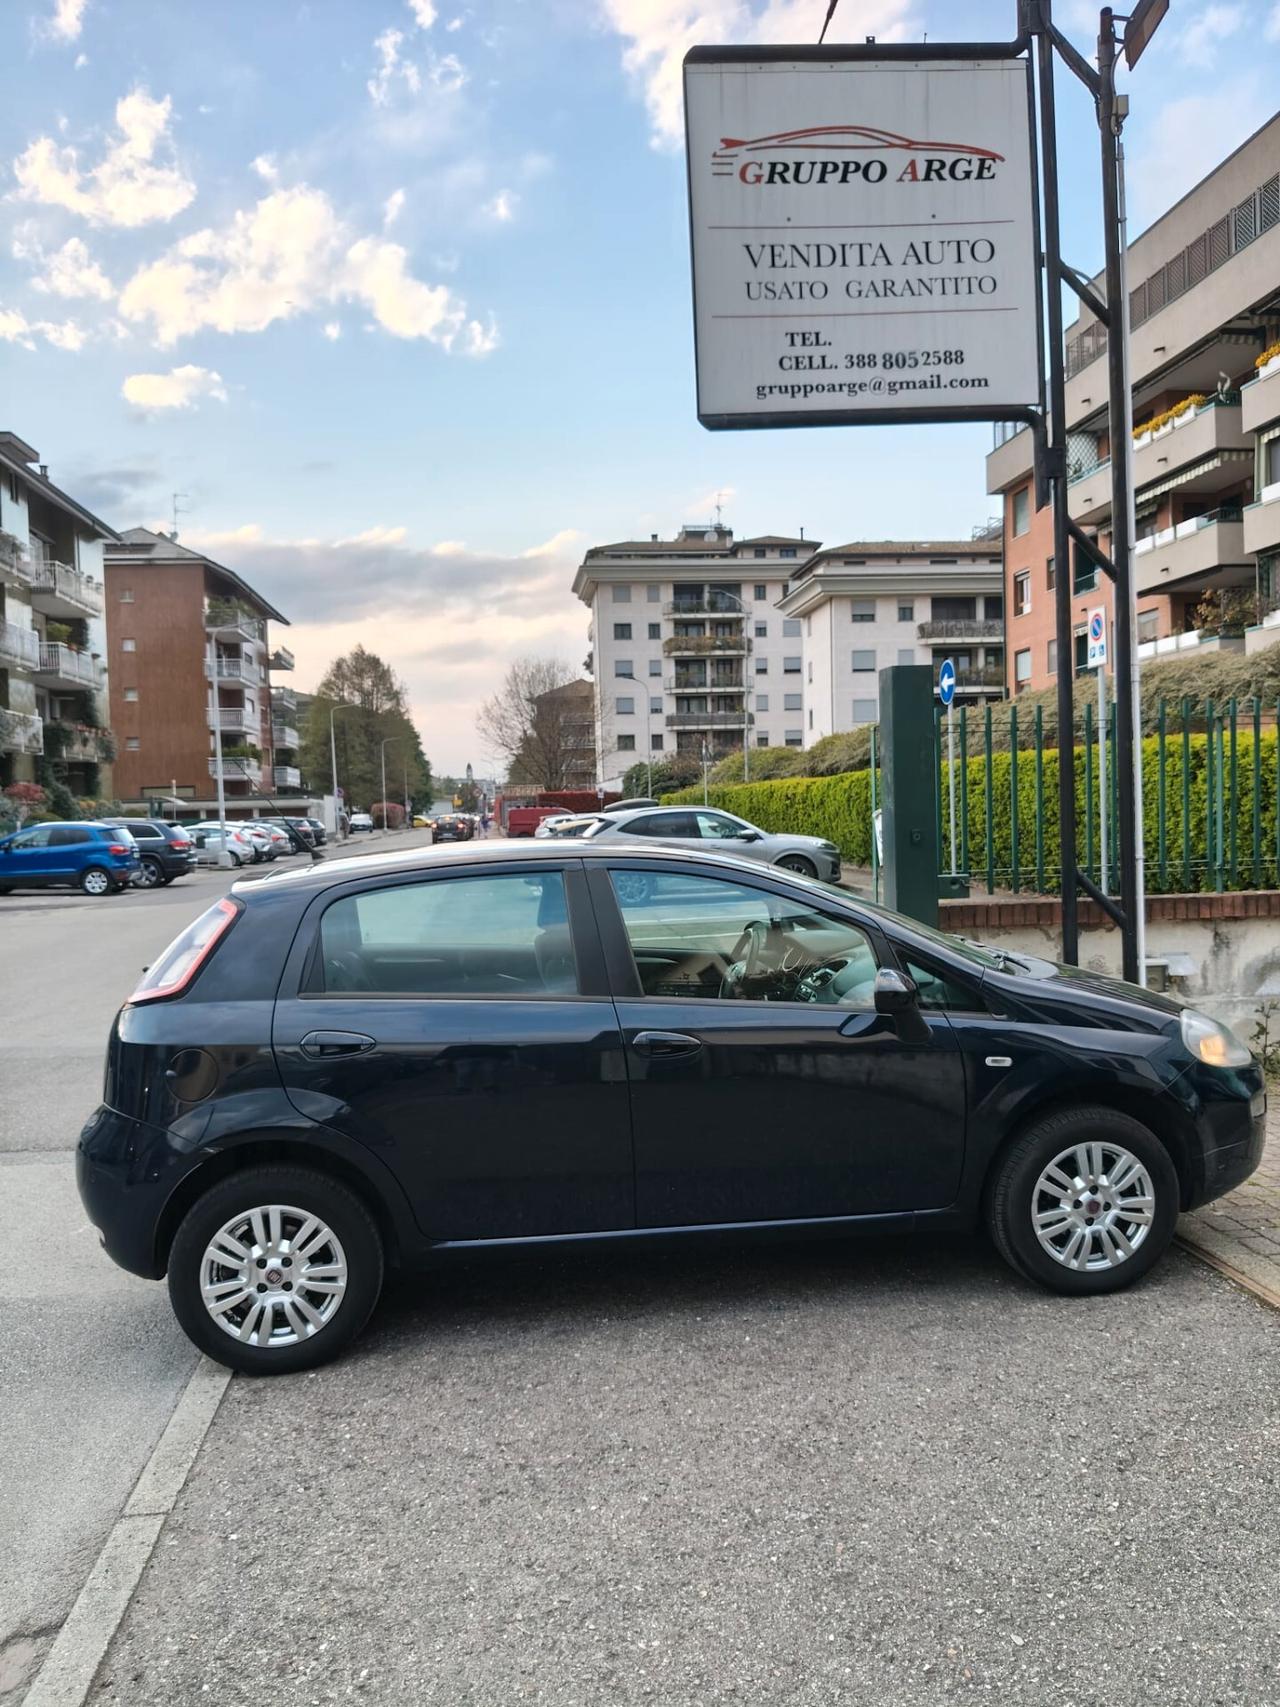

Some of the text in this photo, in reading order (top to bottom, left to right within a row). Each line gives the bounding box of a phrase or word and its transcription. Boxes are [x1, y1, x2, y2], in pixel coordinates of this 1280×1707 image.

[739, 157, 997, 185] GRUPPO ARGE
[743, 239, 995, 269] VENDITA AUTO
[745, 276, 997, 301] USATO GARANTITO
[785, 331, 832, 348] TEL.
[778, 355, 838, 371] CELL.
[844, 352, 877, 370] 388
[755, 374, 990, 400] gruppoarge@gmail.com
